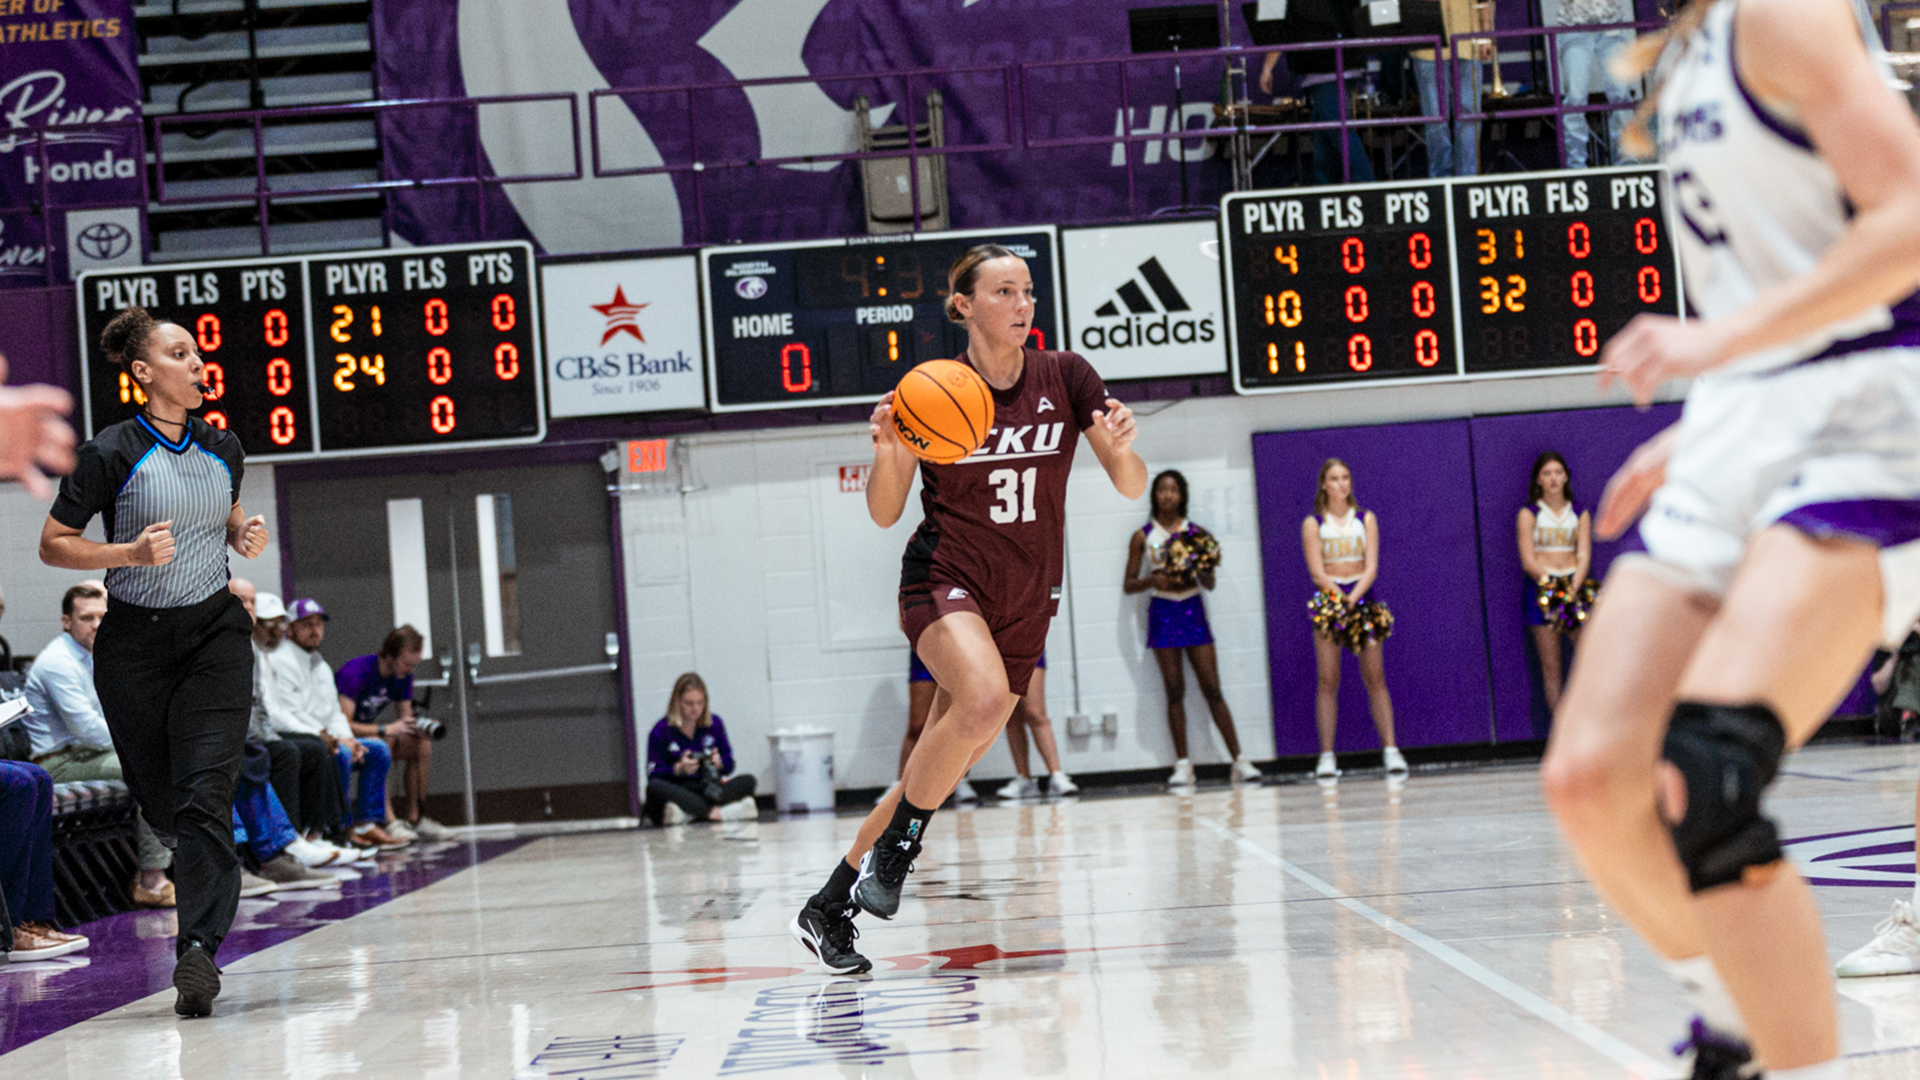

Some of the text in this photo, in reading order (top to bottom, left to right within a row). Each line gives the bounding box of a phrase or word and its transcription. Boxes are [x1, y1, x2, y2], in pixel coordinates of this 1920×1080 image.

[24, 149, 136, 184] Honda
[1243, 192, 1429, 234] PLYR FLS PTS
[1469, 185, 1530, 219] PLYR
[1546, 180, 1590, 214] FLS
[1611, 176, 1656, 210] PTS
[1274, 232, 1432, 276] 4 0 0
[1476, 217, 1659, 265] 31 0 0
[97, 268, 287, 311] PLYR FLS PTS
[325, 253, 514, 296] PLYR FLS PTS
[1479, 265, 1662, 314] 32 0 0
[330, 293, 516, 343] 21 0 0
[856, 304, 914, 325] PERIOD
[1264, 281, 1436, 327] 10 0 0
[197, 309, 289, 351] 0 0
[733, 313, 794, 338] HOME
[888, 331, 899, 361] 1
[1082, 314, 1216, 350] adidas
[1573, 318, 1598, 357] 0
[333, 341, 519, 392] 24 0 0
[555, 351, 693, 381] CB&S Bank
[781, 343, 812, 392] 0
[1267, 329, 1440, 375] 11 0 0
[267, 357, 292, 396] 0
[591, 378, 661, 396] Since 1906
[270, 406, 295, 445] 0
[430, 395, 456, 434] 0
[893, 410, 931, 450] NCAA
[628, 439, 667, 472] EXIT
[988, 467, 1037, 524] 31
